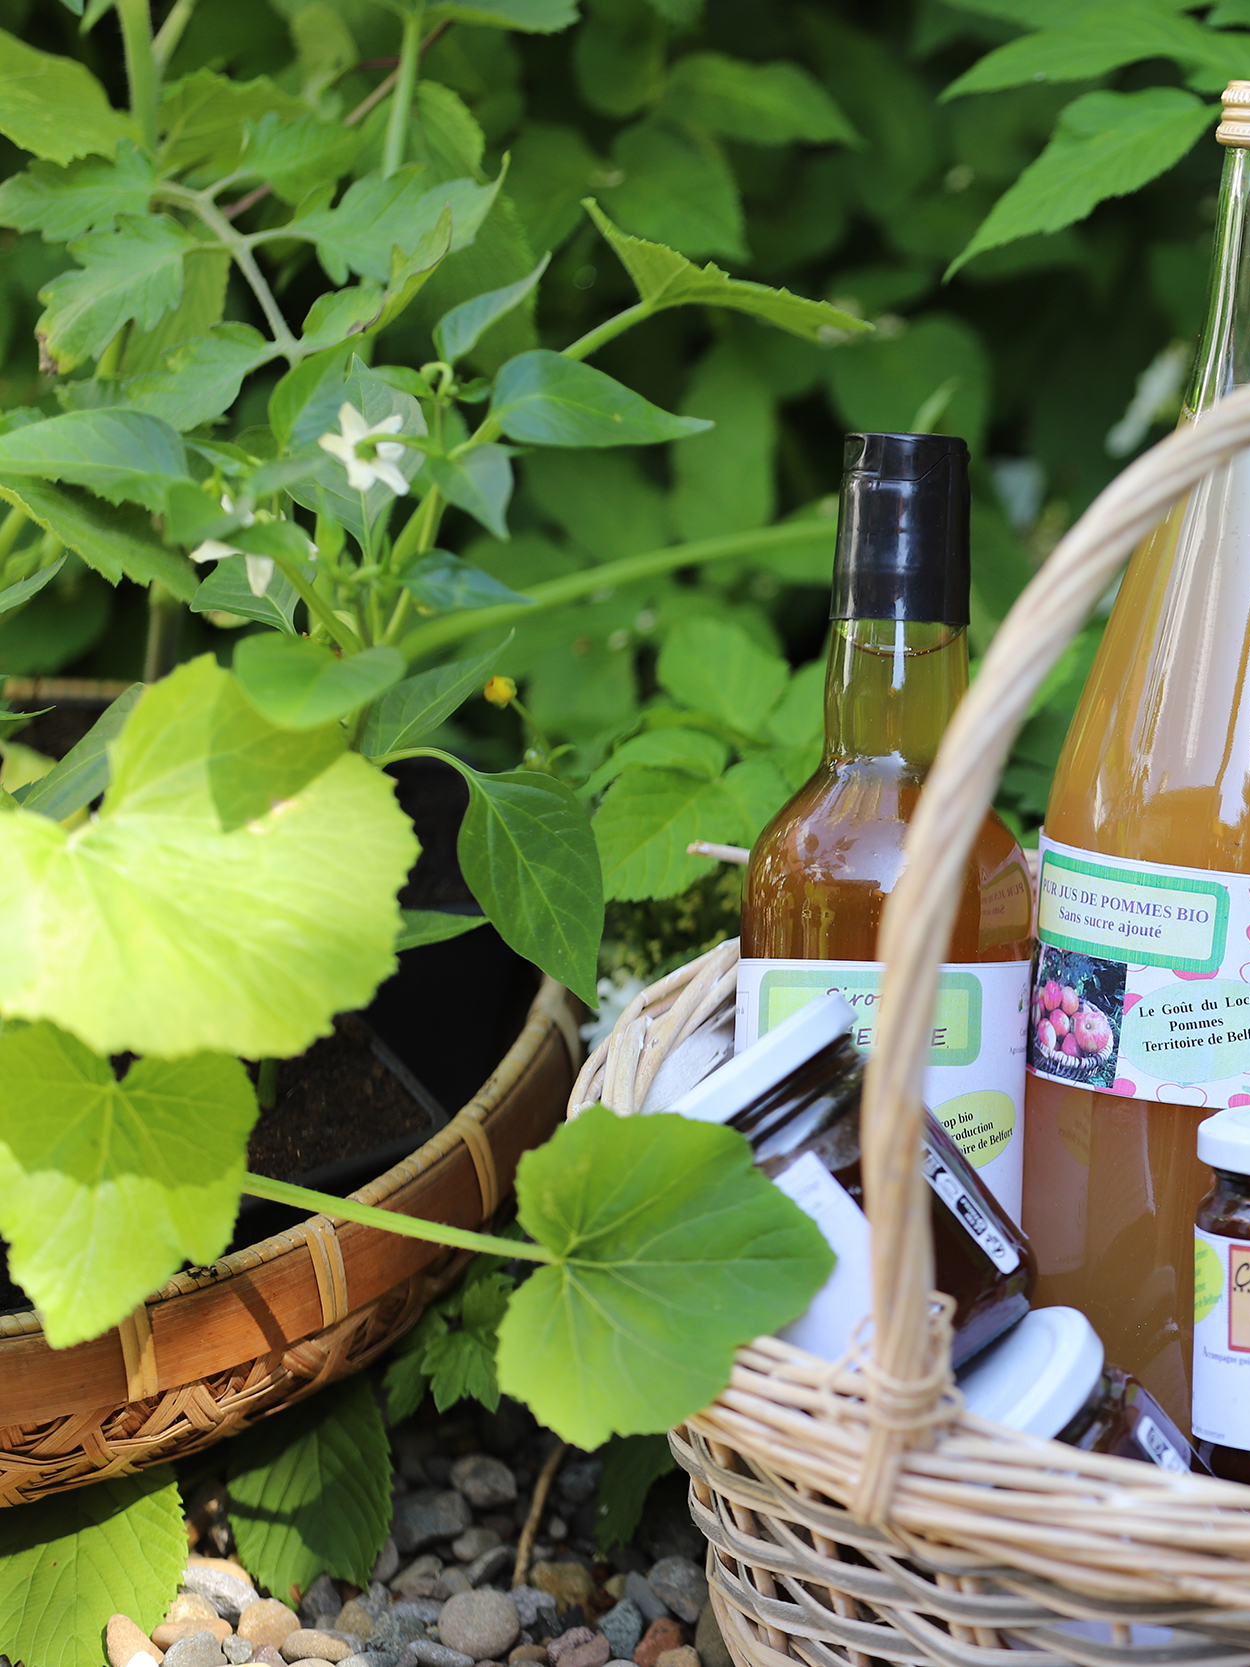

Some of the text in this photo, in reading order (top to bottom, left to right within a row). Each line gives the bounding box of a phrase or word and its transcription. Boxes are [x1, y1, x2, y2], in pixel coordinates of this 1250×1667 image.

[1043, 878, 1209, 924] PUR JUS DE POMMES BIO
[1059, 906, 1162, 939] Sans sucre ajouté
[1139, 1006, 1155, 1018] Le
[1161, 1001, 1194, 1016] Goût
[1201, 999, 1218, 1011] du
[1169, 1017, 1224, 1032] Pommes
[1142, 1036, 1204, 1053] Territoire
[1207, 1033, 1223, 1046] de
[958, 1111, 974, 1124] bio
[951, 1121, 994, 1141] roduction
[978, 1138, 988, 1150] de
[989, 1128, 1013, 1146] Belfort
